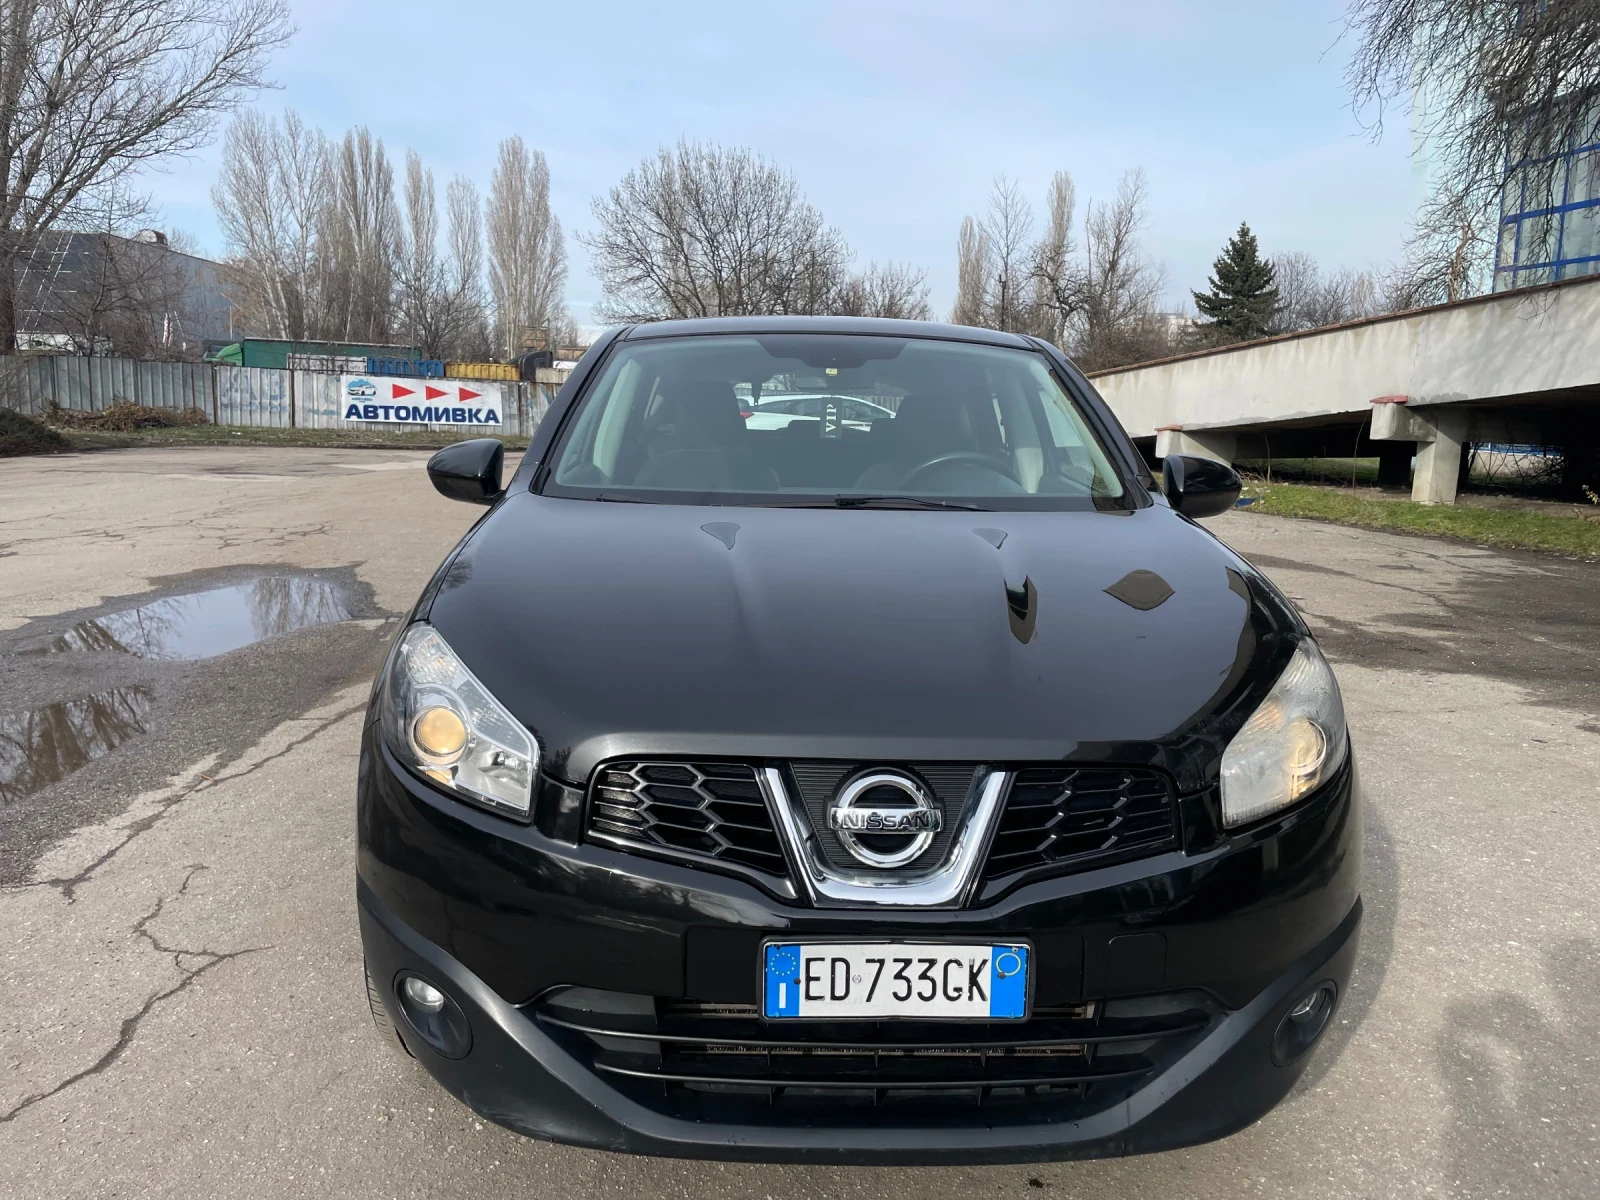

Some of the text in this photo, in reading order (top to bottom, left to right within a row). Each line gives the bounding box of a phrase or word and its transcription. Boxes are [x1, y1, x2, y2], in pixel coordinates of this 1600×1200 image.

[345, 404, 500, 424] АВТОМИВКА
[825, 403, 836, 432] VIP
[842, 813, 929, 830] NISSAN
[805, 957, 851, 1001] ED
